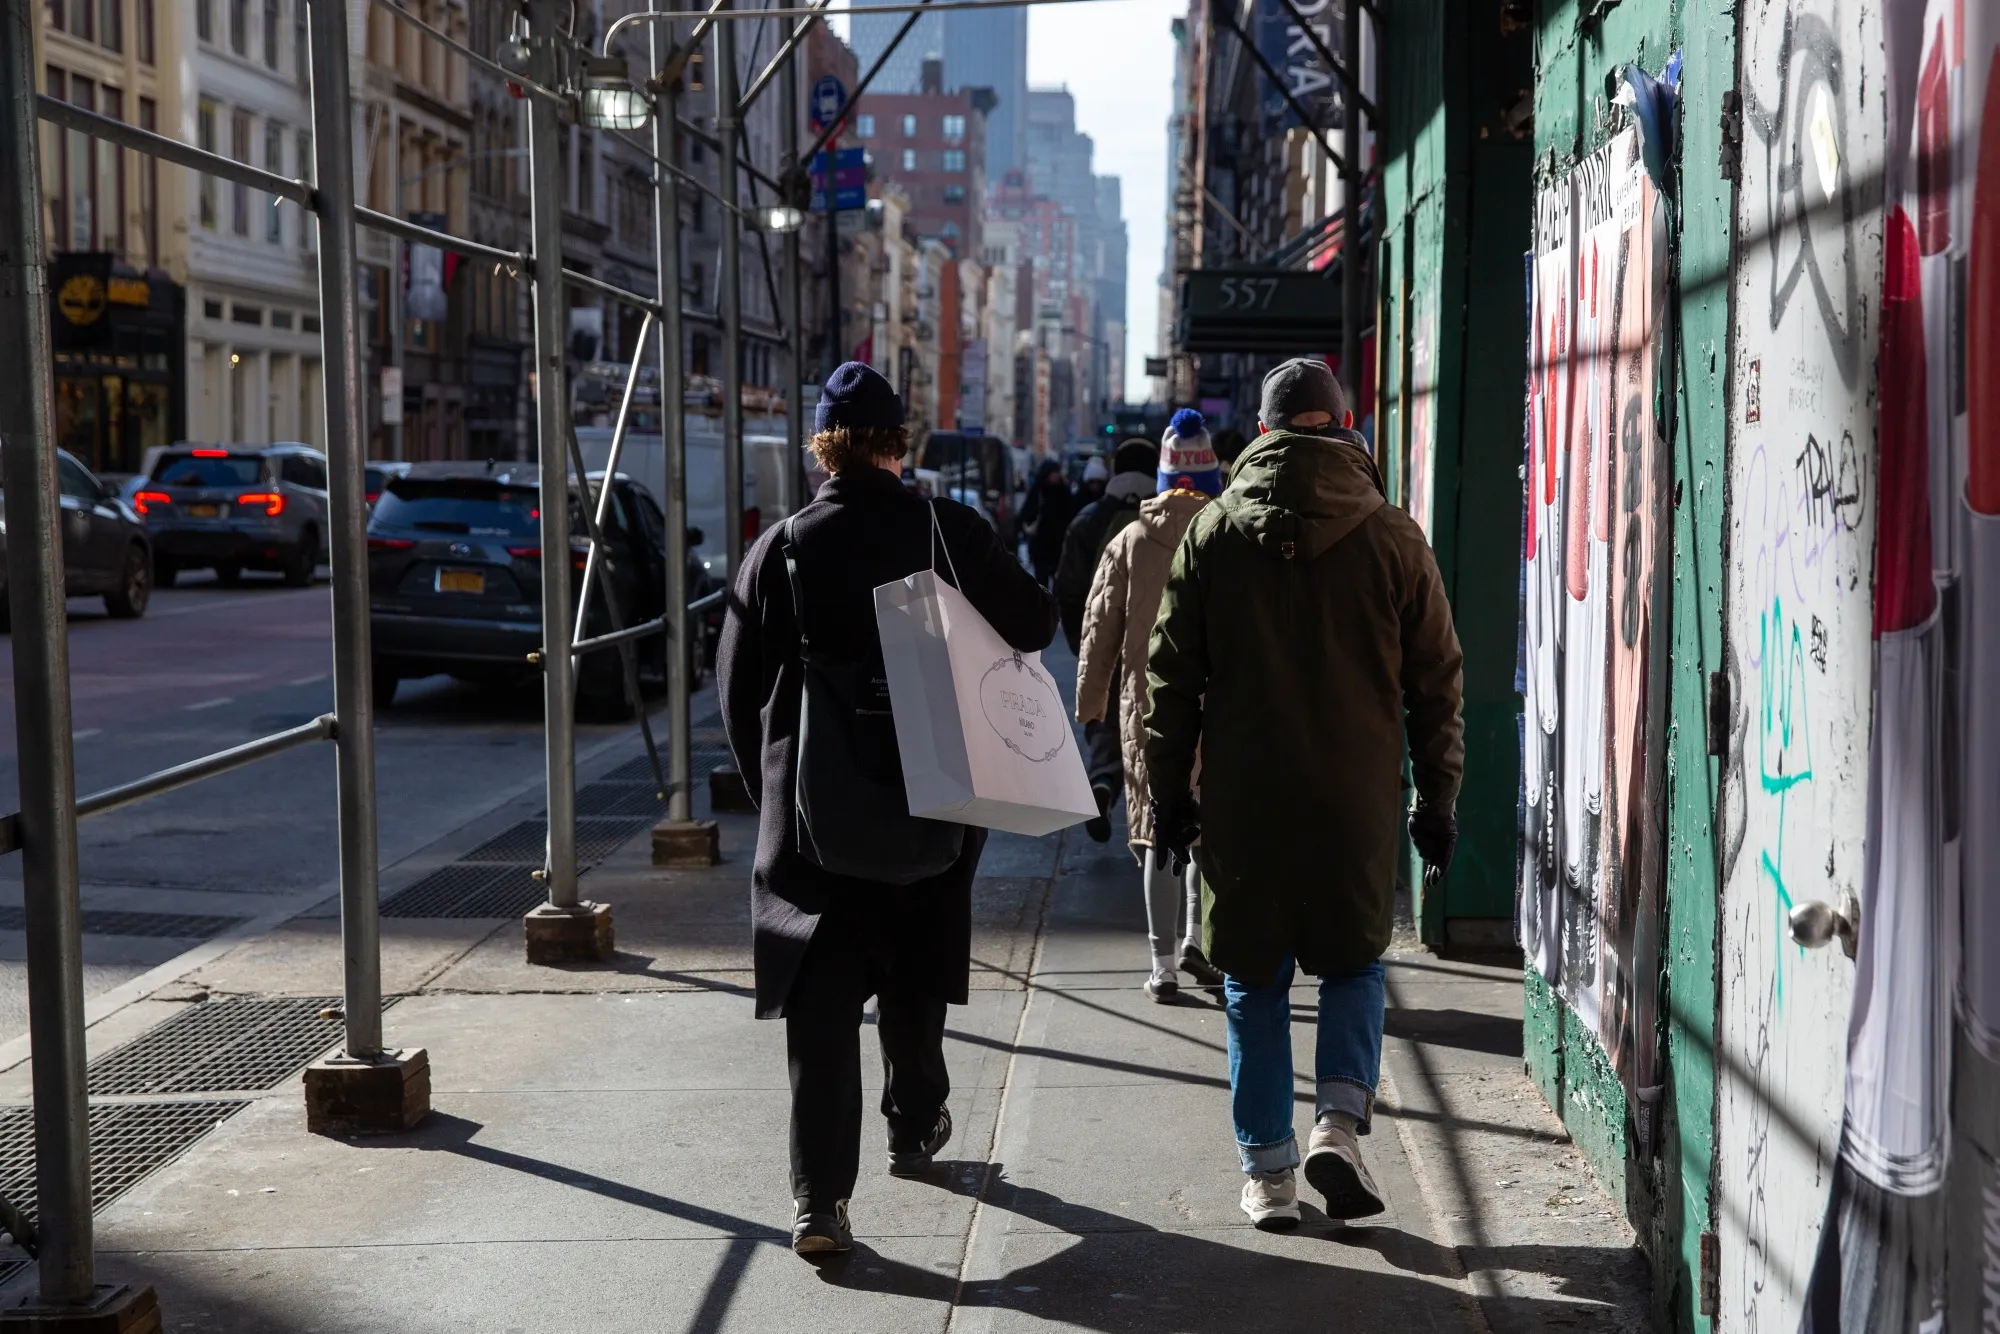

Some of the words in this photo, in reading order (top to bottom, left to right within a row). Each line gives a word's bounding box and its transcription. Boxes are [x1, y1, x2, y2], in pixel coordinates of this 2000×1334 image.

[1218, 277, 1279, 311] 557
[1000, 691, 1046, 718] PRADA
[1546, 786, 1554, 869] MARIO
